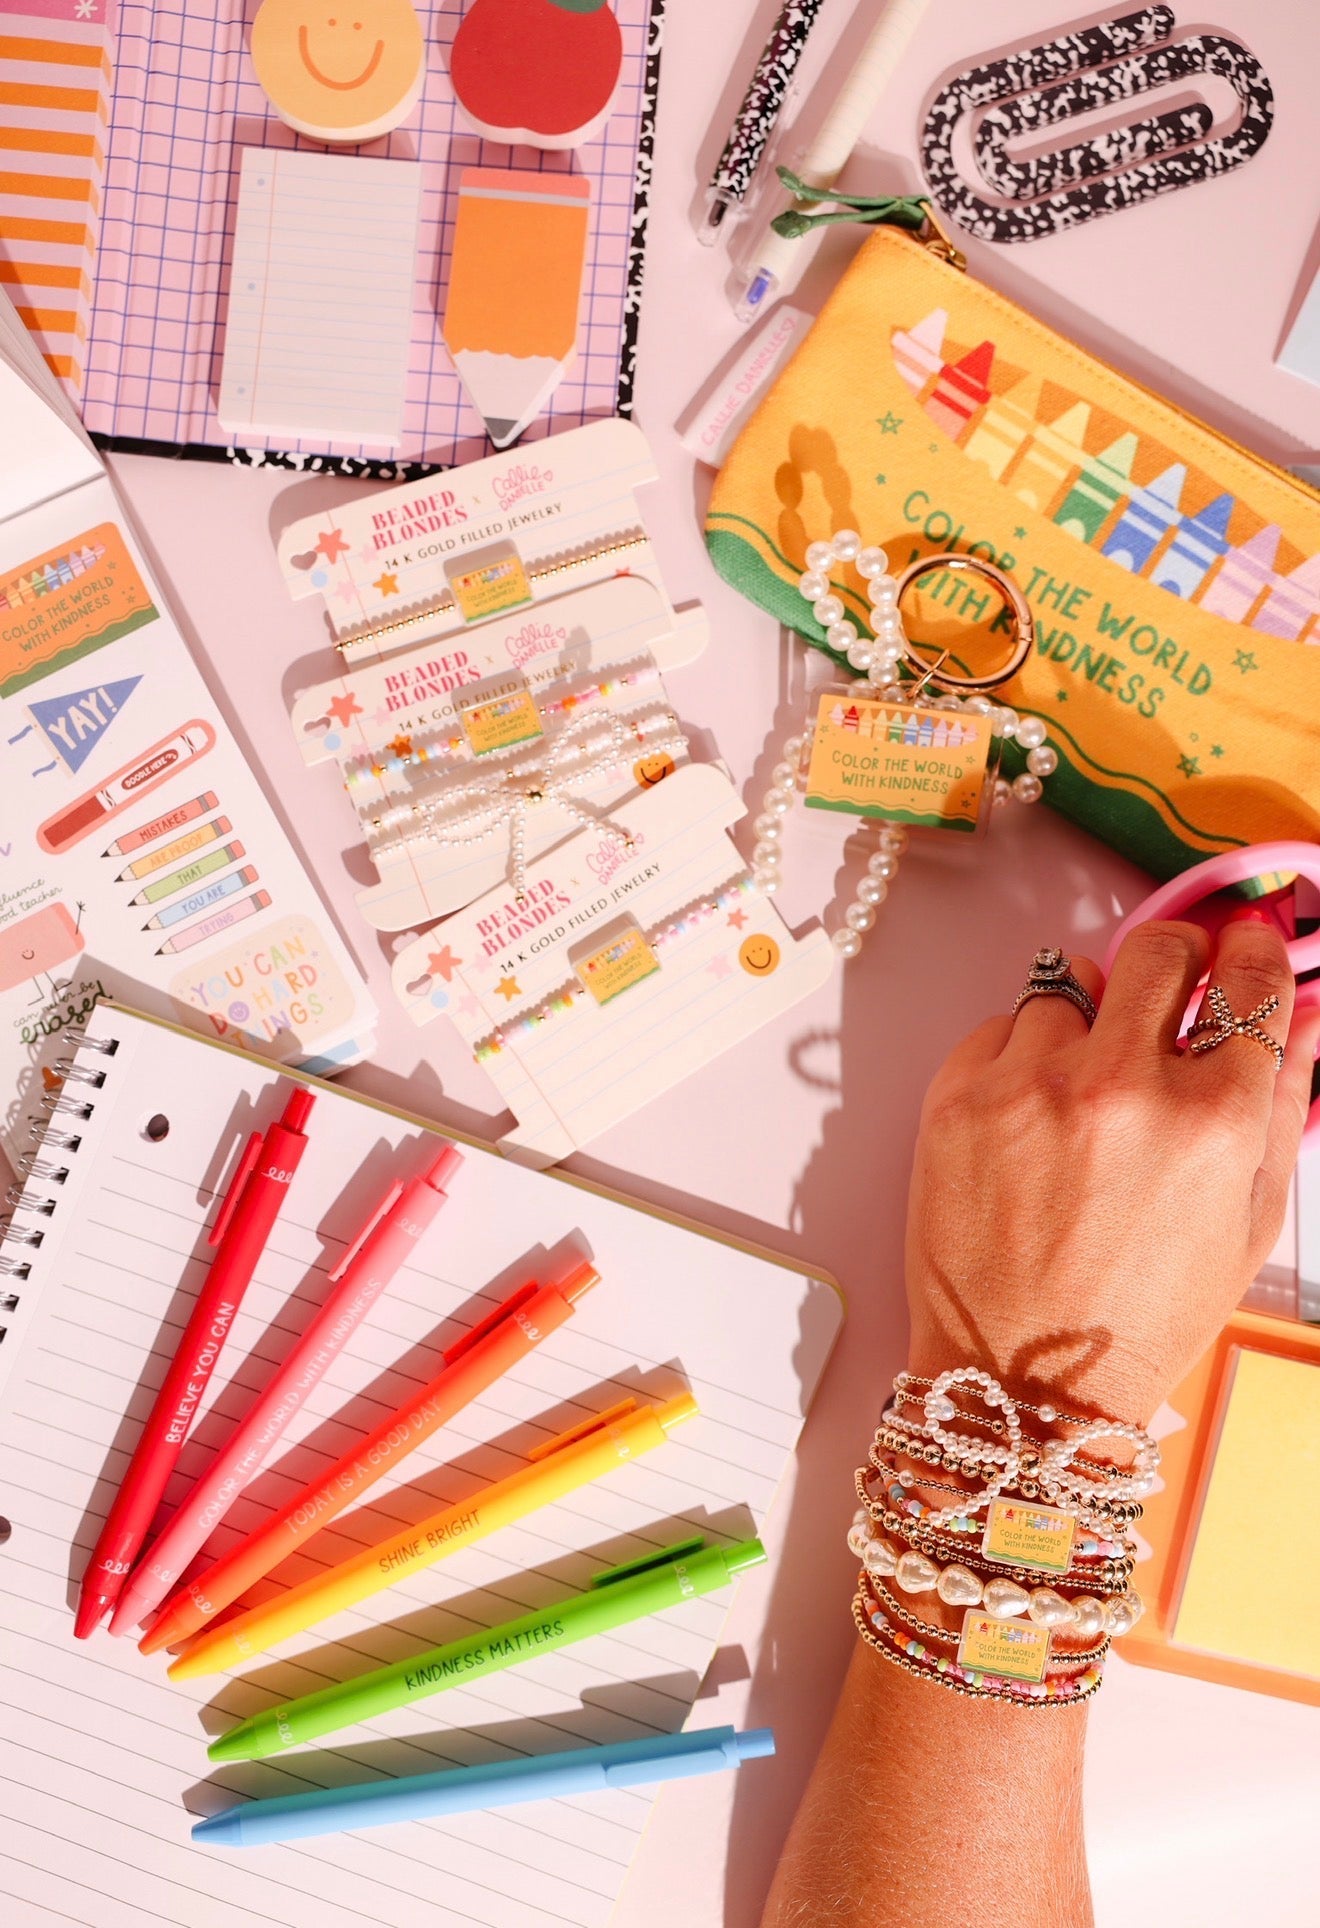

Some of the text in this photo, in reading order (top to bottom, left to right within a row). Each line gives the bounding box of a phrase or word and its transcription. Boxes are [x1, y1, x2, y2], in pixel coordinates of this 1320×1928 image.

[701, 331, 789, 446] CALLIE DANIELLE
[371, 490, 456, 531] BEADED
[372, 506, 469, 551] BLONDES
[385, 503, 563, 570] 14 K GOLD FILLED JEWELRY
[2, 576, 115, 642] COLOR THE WORLD
[20, 594, 111, 652] WITH KINDNESS
[1025, 566, 1092, 620] THE
[1096, 602, 1213, 696] WORLD
[384, 651, 468, 693] BEADED
[385, 666, 482, 712] BLONDES
[48, 686, 118, 750] YAY!
[399, 719, 413, 732] 14
[418, 716, 427, 725] K
[432, 698, 470, 720] GOLD
[522, 660, 577, 689] JEWELRY
[124, 756, 168, 788] DOODLE HERE
[832, 750, 963, 780] COLOR THE WORLD
[841, 771, 949, 795] WITH KINDNESS
[139, 810, 188, 841] MISTAKES
[150, 834, 204, 868] ARE PROOF
[177, 865, 203, 885] THAT
[20, 887, 63, 911] teacher
[182, 885, 226, 914] YOU ARE
[500, 861, 663, 974] 14 K GOLD FILLED JEWELRY
[199, 912, 235, 936] TRYING
[480, 890, 571, 957] BLONDES
[190, 935, 306, 1007] YOU CAN
[252, 964, 318, 1010] HARD
[13, 1012, 39, 1028] can
[20, 980, 113, 1044] erased
[165, 1302, 235, 1443] BELIEVE YOU CAN
[198, 1278, 382, 1529] COLOR THE WORLD WITH KINDNESS
[284, 1397, 441, 1534] TODAY IS A GOOD DAY
[378, 1508, 481, 1574] SHINE BRIGHT
[1000, 1529, 1024, 1540] COLOR
[1038, 1536, 1062, 1547] WORLD
[1004, 1540, 1055, 1554] WITH KINDNESS
[404, 1620, 565, 1691] KINDNESS MATTERS
[979, 1652, 996, 1661] WITH
[1012, 1648, 1036, 1659] WORLD
